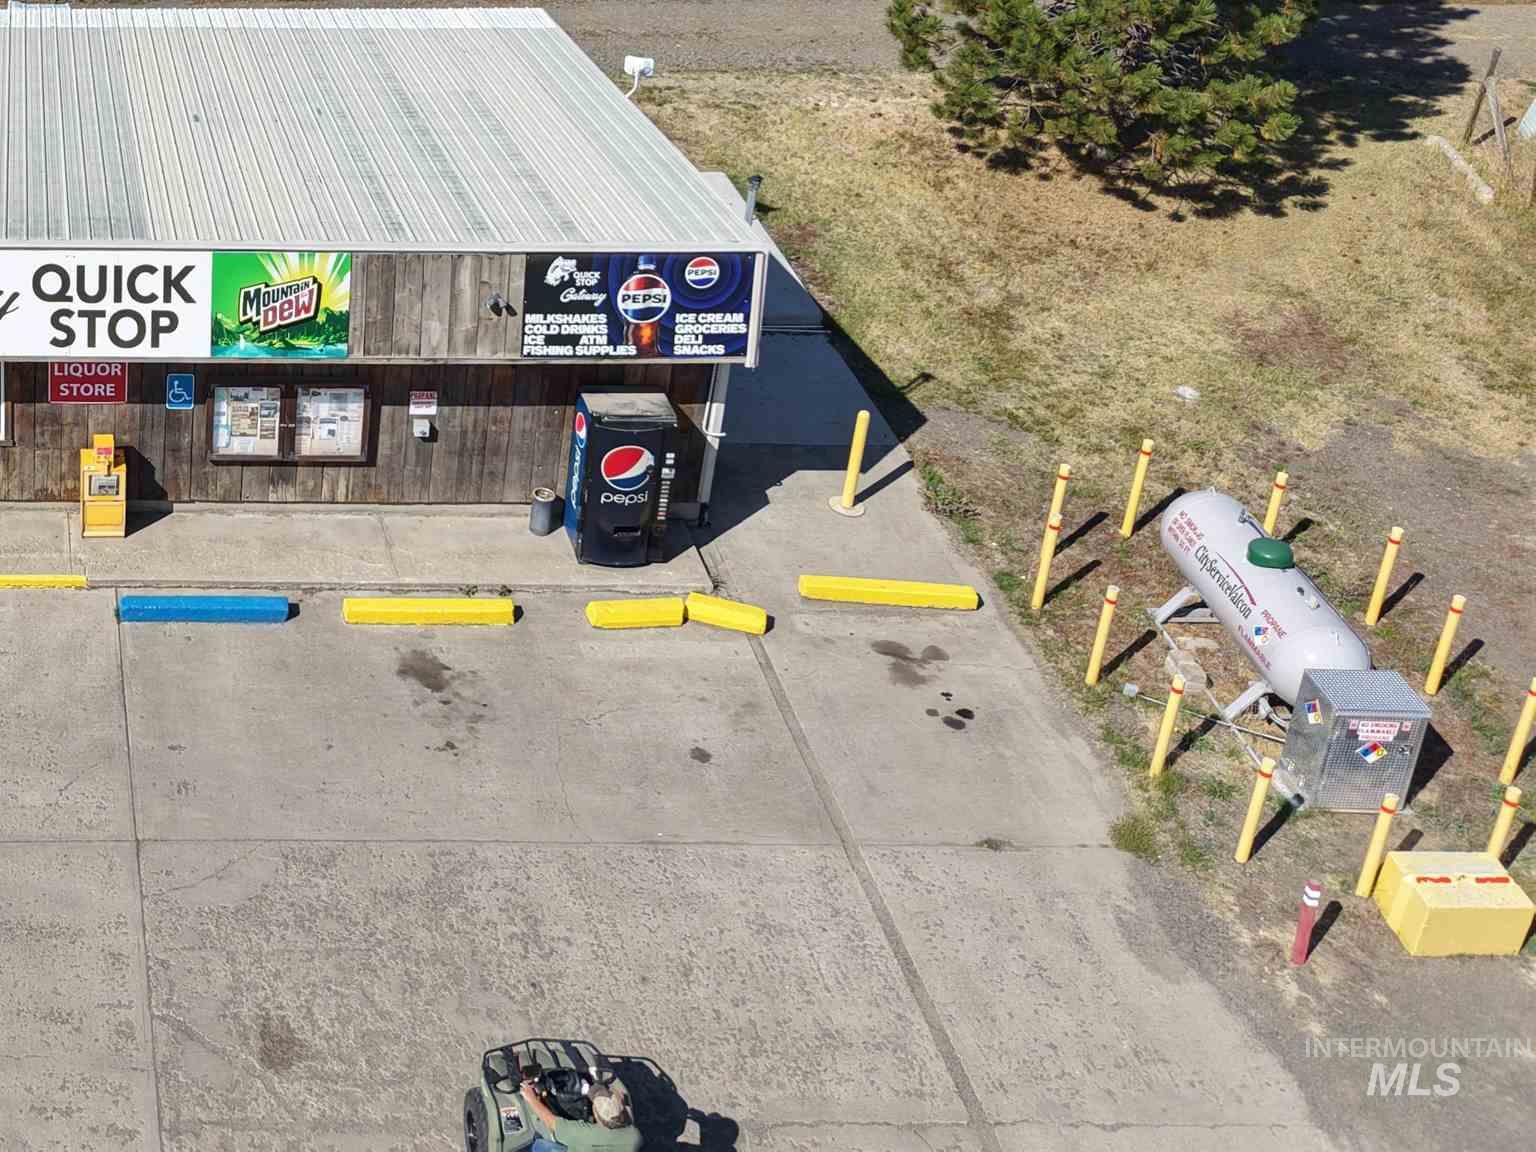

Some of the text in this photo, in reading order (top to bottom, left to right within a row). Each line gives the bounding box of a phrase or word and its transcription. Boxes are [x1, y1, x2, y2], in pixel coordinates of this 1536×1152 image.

[573, 271, 601, 279] QUICK
[31, 263, 196, 304] QUICK
[559, 287, 607, 306] Gateway
[621, 293, 667, 304] PEPSI
[525, 314, 607, 323] MILKSHAKES
[675, 313, 744, 323] ICE CREAM
[50, 308, 179, 348] STOP
[524, 324, 608, 334] COLD DRINKS
[675, 324, 747, 334] GROCERIES
[524, 335, 545, 345] ICE
[579, 335, 608, 345] ATM
[674, 335, 703, 344] DELI
[523, 345, 637, 355] FISHING SUPPLIES
[673, 345, 725, 355] SNACKS
[54, 363, 122, 377] LIQUOR
[59, 384, 116, 396] STORE
[571, 444, 582, 510] pepsi
[600, 491, 649, 506] pepsi
[1194, 544, 1254, 619] CityServiceValcon
